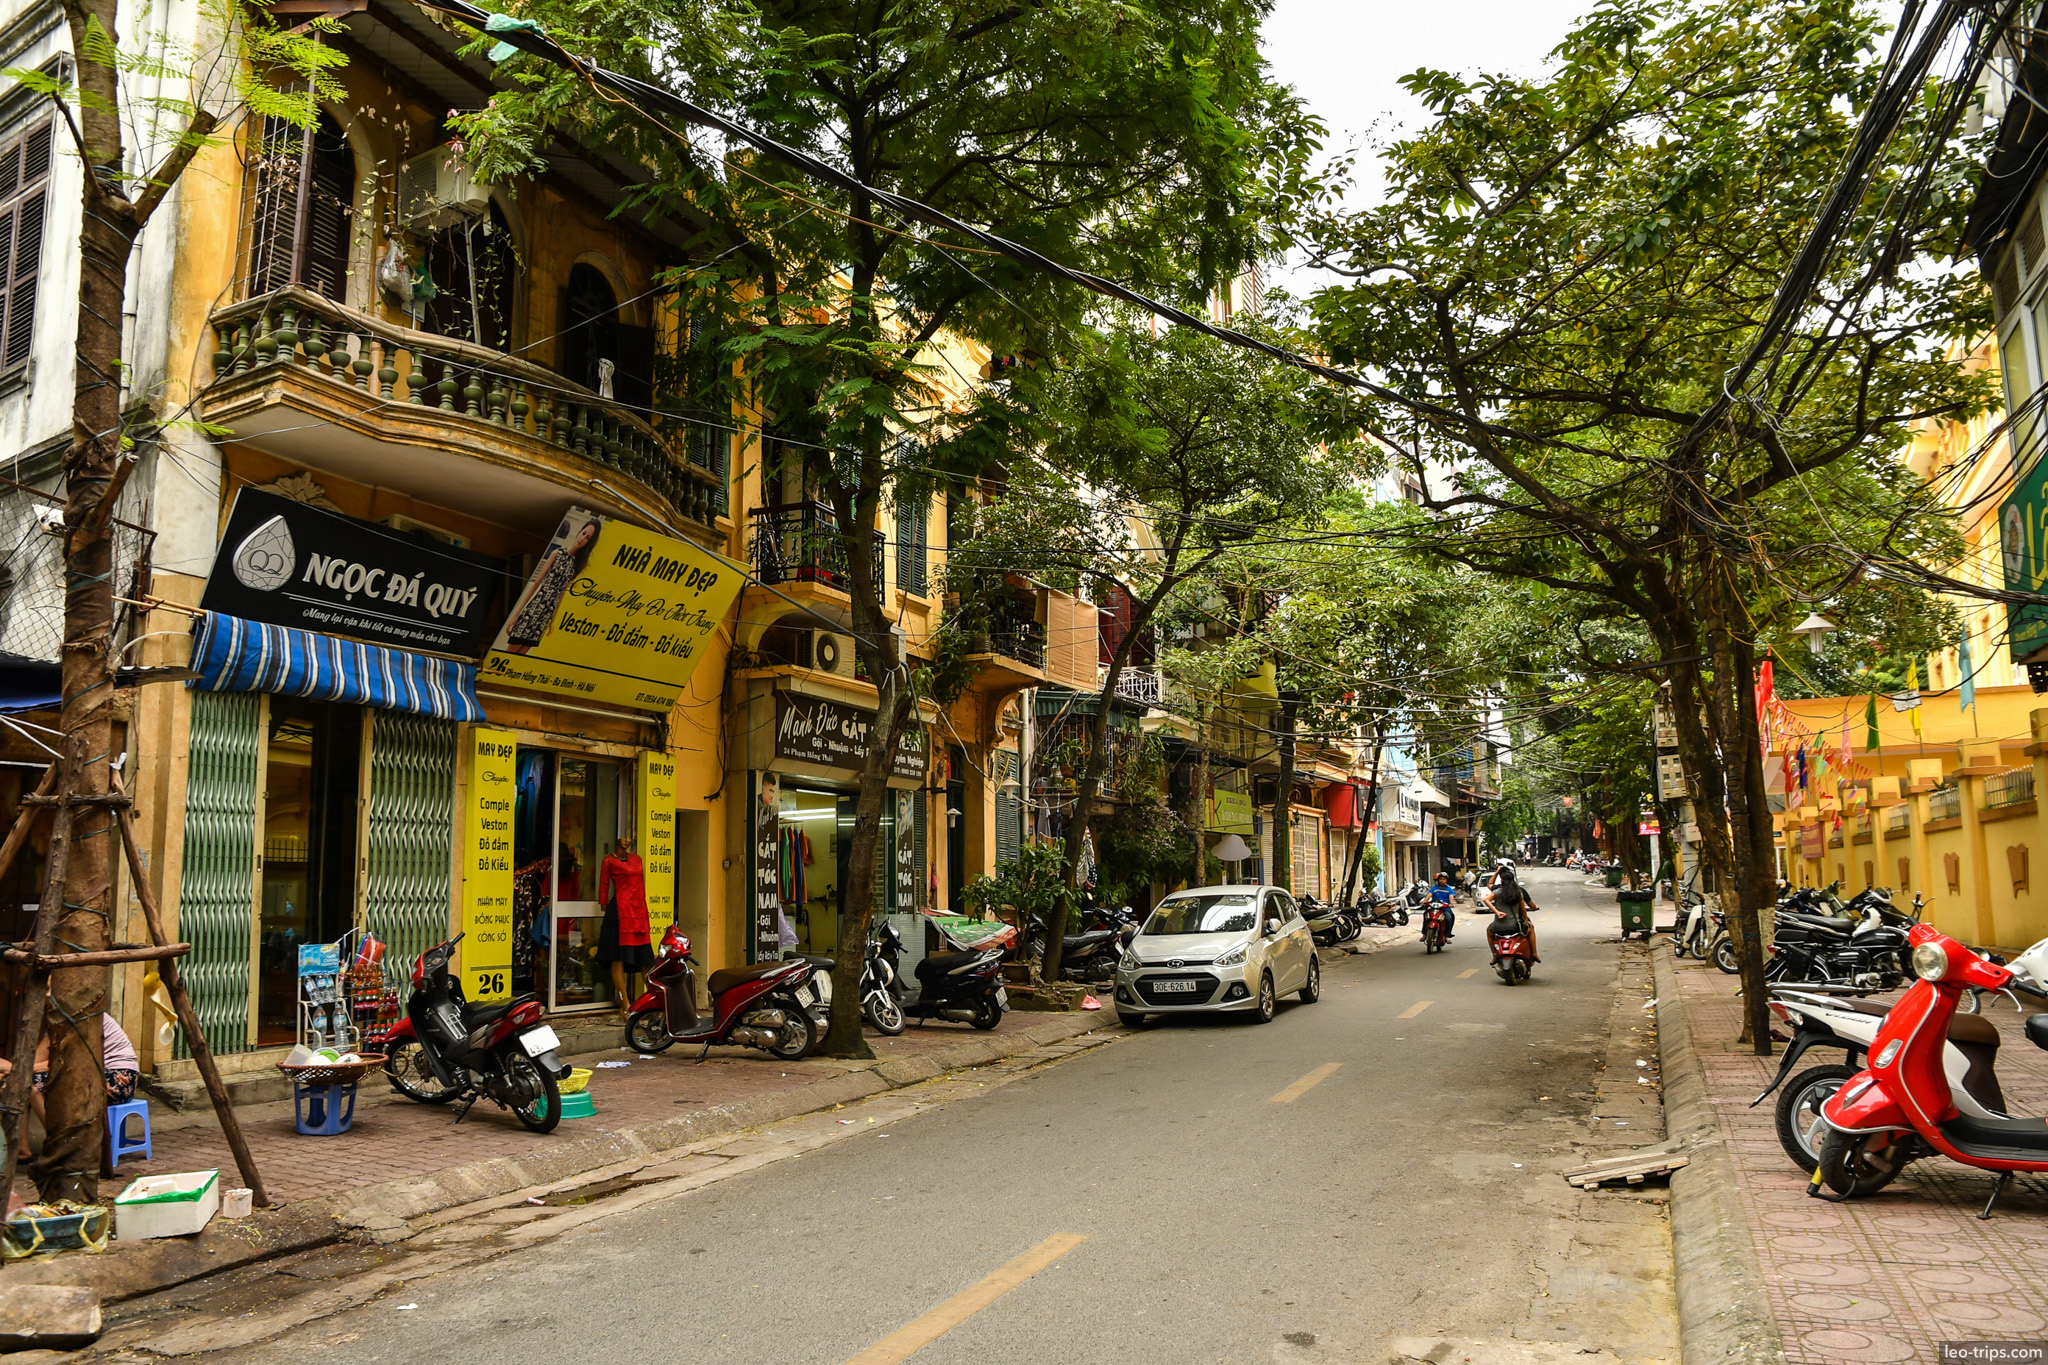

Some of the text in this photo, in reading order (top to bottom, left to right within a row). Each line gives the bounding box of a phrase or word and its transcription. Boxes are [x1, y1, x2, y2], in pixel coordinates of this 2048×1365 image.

[612, 544, 718, 598] NHÀ MAY ĐẸP
[302, 552, 478, 618] NGỌC ĐÁ QUÝ
[569, 578, 616, 607] Chuyên
[616, 590, 645, 617] May
[686, 609, 716, 636] Trang
[302, 608, 332, 623] Mang
[331, 612, 344, 624] lại
[343, 617, 358, 628] vận
[358, 618, 371, 630] khí
[372, 622, 384, 632] tốt
[384, 626, 394, 634] và
[394, 628, 409, 638] may
[425, 634, 438, 642] cho
[438, 636, 450, 646] bạn
[558, 612, 694, 659] Veston Đồ đầm Đồ kiểu
[485, 657, 510, 676] 26
[504, 668, 520, 680] Phạm
[552, 677, 561, 686] Ba
[778, 705, 813, 744] Mạnh
[816, 702, 838, 735] Đức
[842, 712, 866, 742] CẮT
[478, 742, 513, 762] MAY ĐẸP
[812, 736, 822, 750] Gội
[828, 740, 849, 754] Nhuộm
[854, 745, 864, 758] Lấy
[907, 755, 924, 769] Nghiệp
[649, 762, 674, 780] MAY ĐẸP
[480, 798, 510, 814] Comple
[481, 818, 508, 830] Veston
[651, 810, 671, 824] Comple
[652, 828, 670, 839] Veston
[758, 834, 777, 860] CẮT
[898, 842, 912, 866] CẮT
[491, 856, 509, 870] Kiểu
[659, 861, 671, 873] Kiểu
[758, 864, 777, 887] TÓC
[898, 868, 912, 888] TÓC
[478, 896, 508, 908] NHẬN MAY
[758, 892, 778, 910] NAM
[898, 893, 913, 907] NAM
[475, 912, 492, 924] ĐỒNG
[478, 931, 495, 942] CÔNG
[479, 973, 504, 994] 26
[1154, 982, 1195, 991] 30E-626.14
